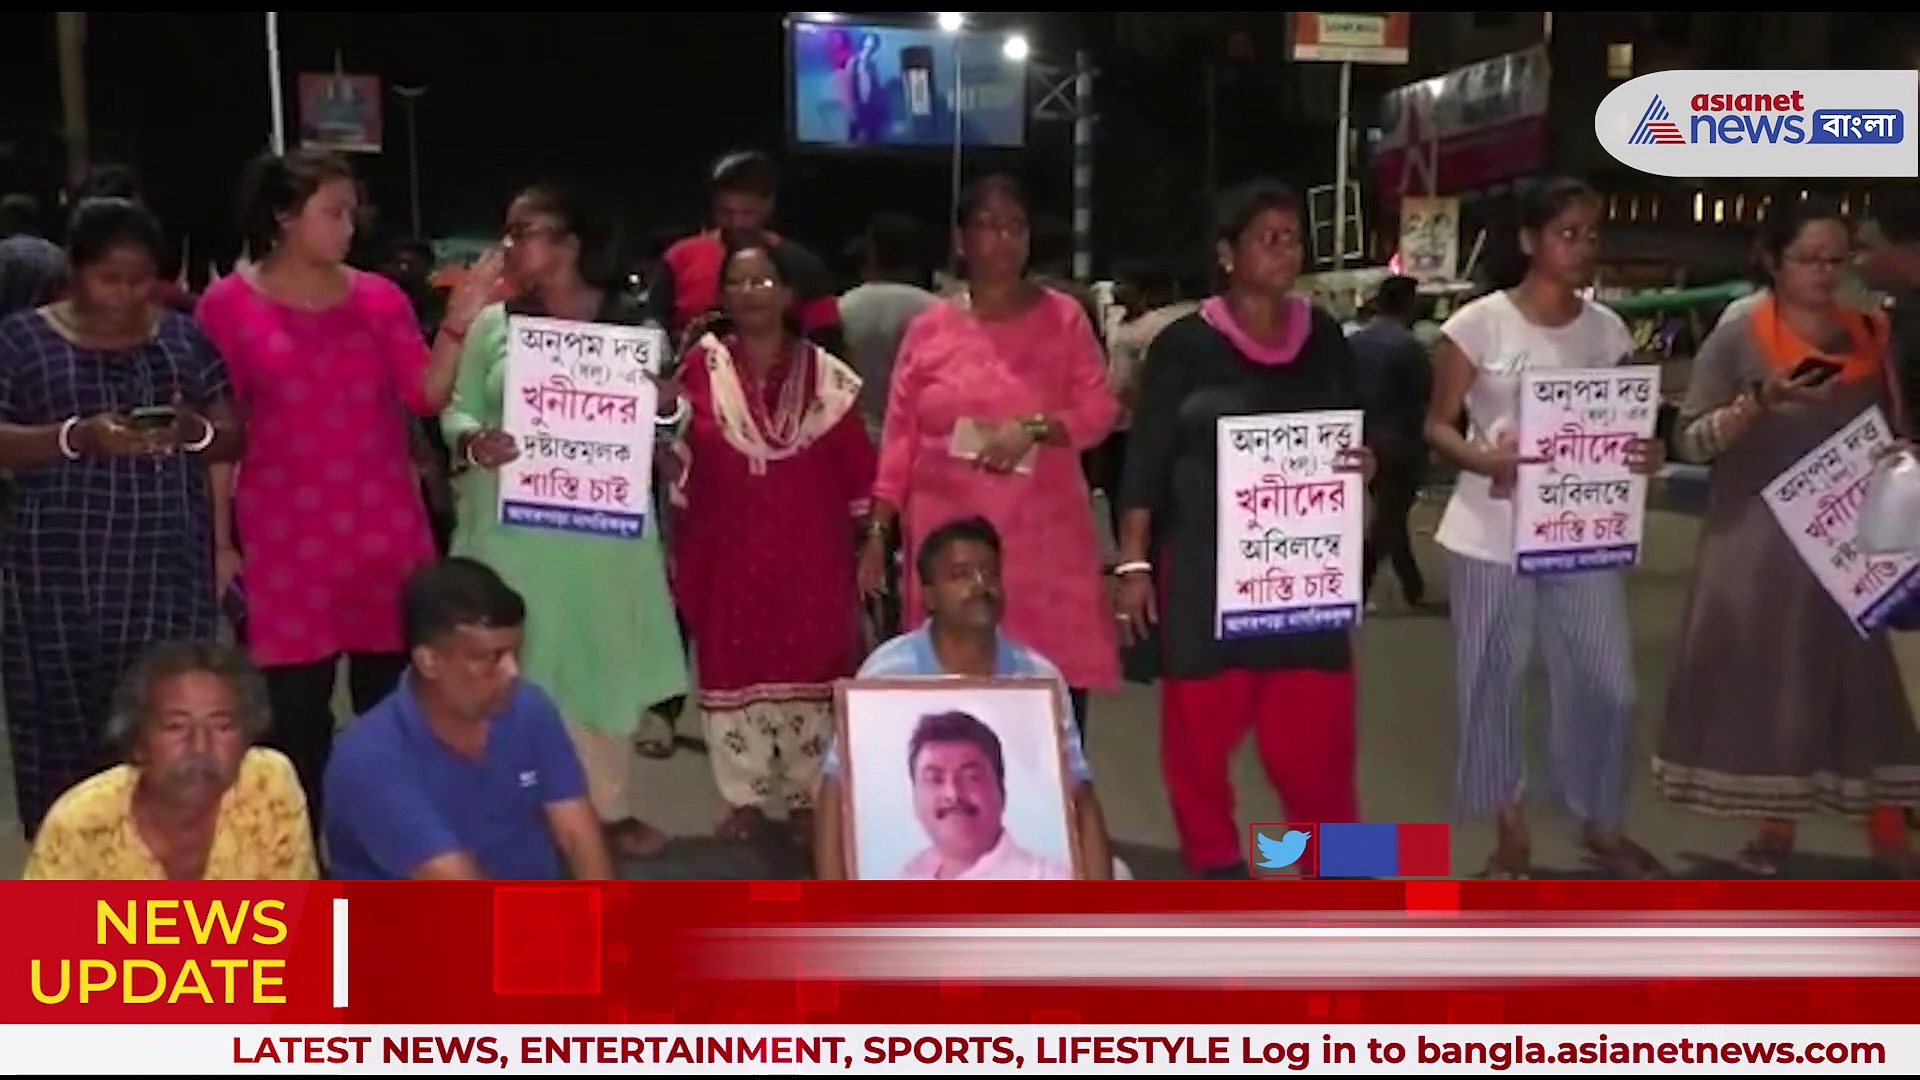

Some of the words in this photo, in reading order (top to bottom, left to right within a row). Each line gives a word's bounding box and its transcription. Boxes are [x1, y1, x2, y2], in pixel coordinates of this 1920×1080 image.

[520, 329, 604, 367] অনুপম
[613, 337, 651, 364] দত্ত
[523, 375, 640, 428] খুনীদের
[1534, 379, 1610, 411] অনুপম
[1616, 377, 1650, 402] দত্ত
[1230, 424, 1309, 463] অনুপম
[520, 467, 579, 500] শাস্তি
[589, 476, 631, 507] চাই
[1235, 474, 1345, 530] খুনীদের
[1239, 527, 1341, 564] অবিলম্বে
[1533, 510, 1586, 543] শাস্তি
[1593, 512, 1630, 540] চাই
[1235, 567, 1295, 604] শাস্তি
[1303, 566, 1344, 599] চাই
